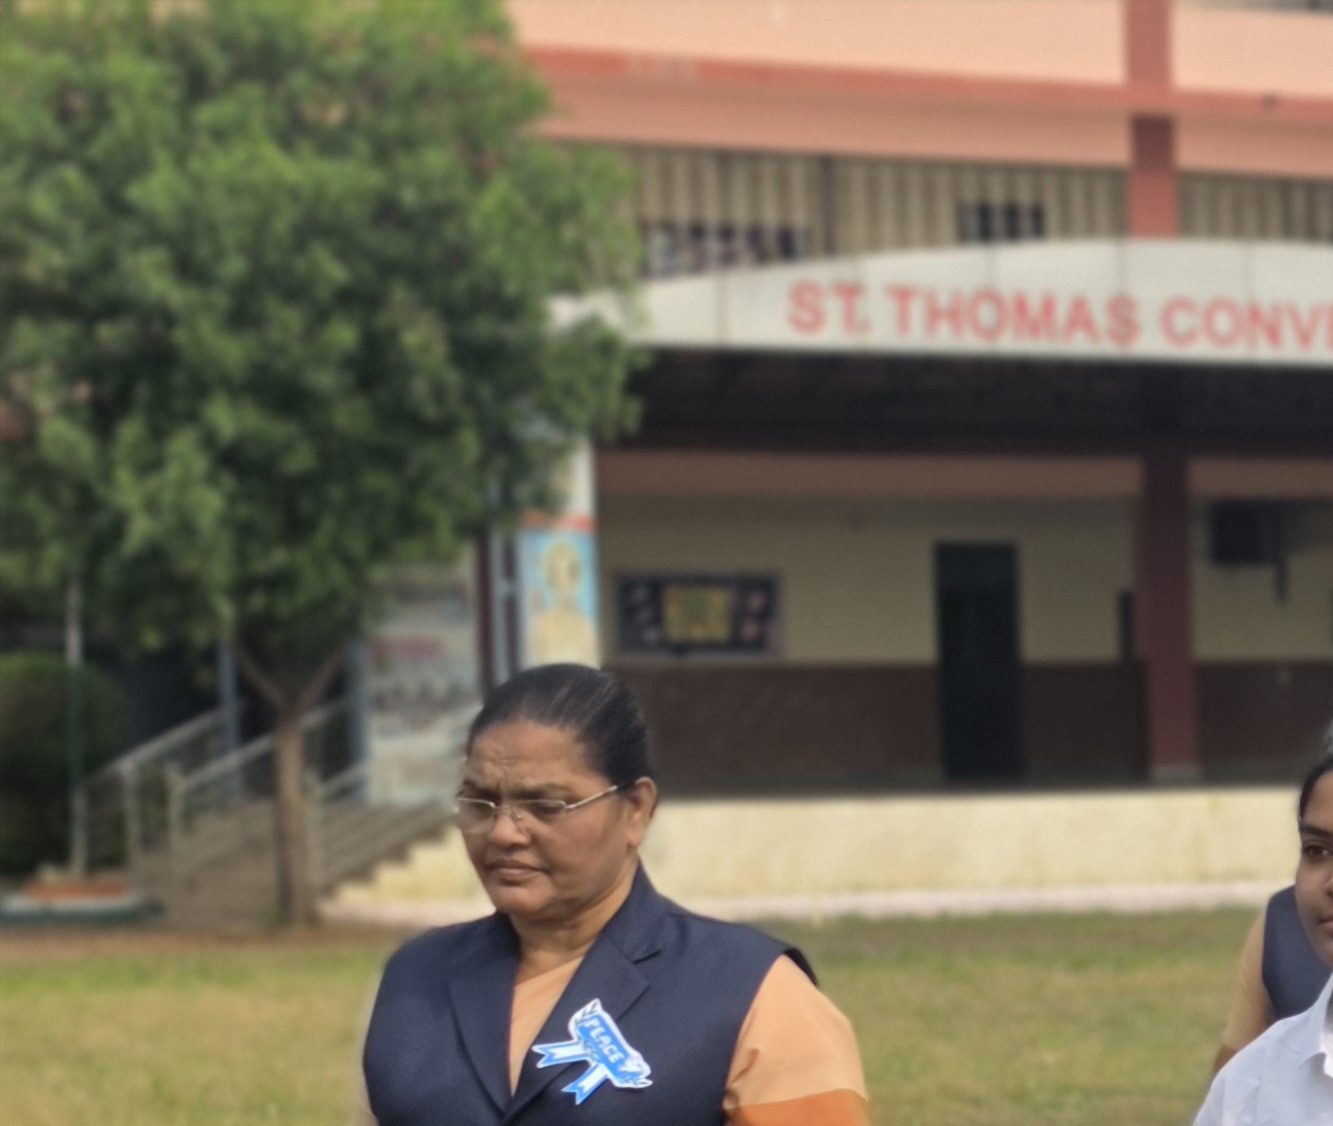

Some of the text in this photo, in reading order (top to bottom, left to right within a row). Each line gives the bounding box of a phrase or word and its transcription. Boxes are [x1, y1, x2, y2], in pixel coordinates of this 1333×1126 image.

[788, 282, 872, 336] ST.
[886, 285, 1140, 347] THOMAS
[584, 1018, 625, 1063] PEACE
